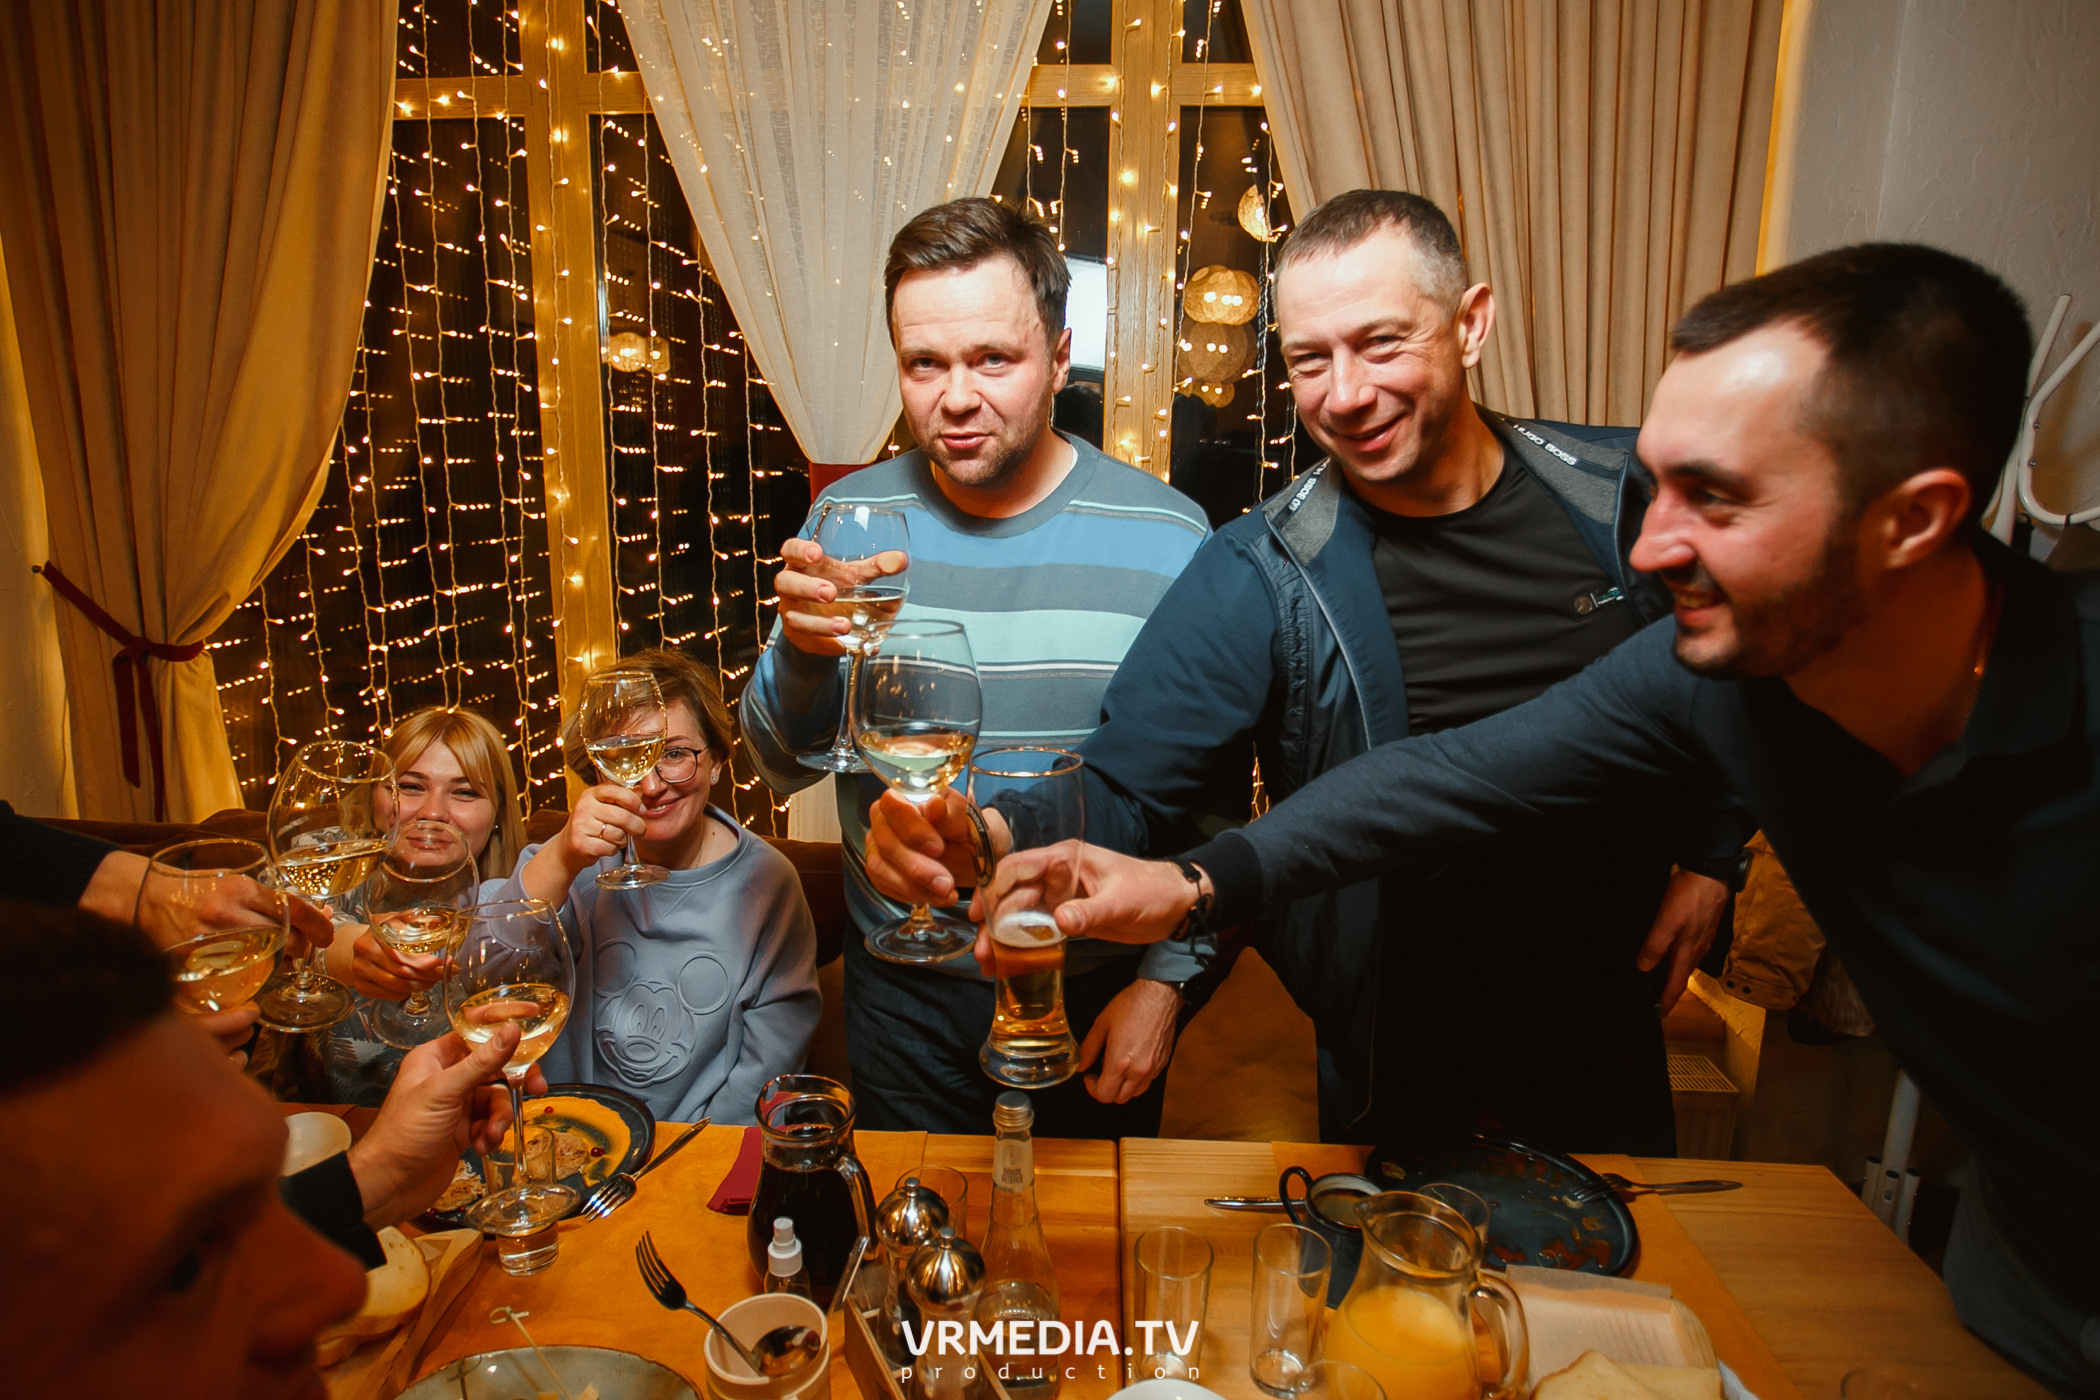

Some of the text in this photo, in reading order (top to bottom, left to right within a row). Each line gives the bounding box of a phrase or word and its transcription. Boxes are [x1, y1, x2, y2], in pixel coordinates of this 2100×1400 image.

[1513, 424, 1577, 466] HUGO BOSS
[1296, 477, 1317, 500] BOSS
